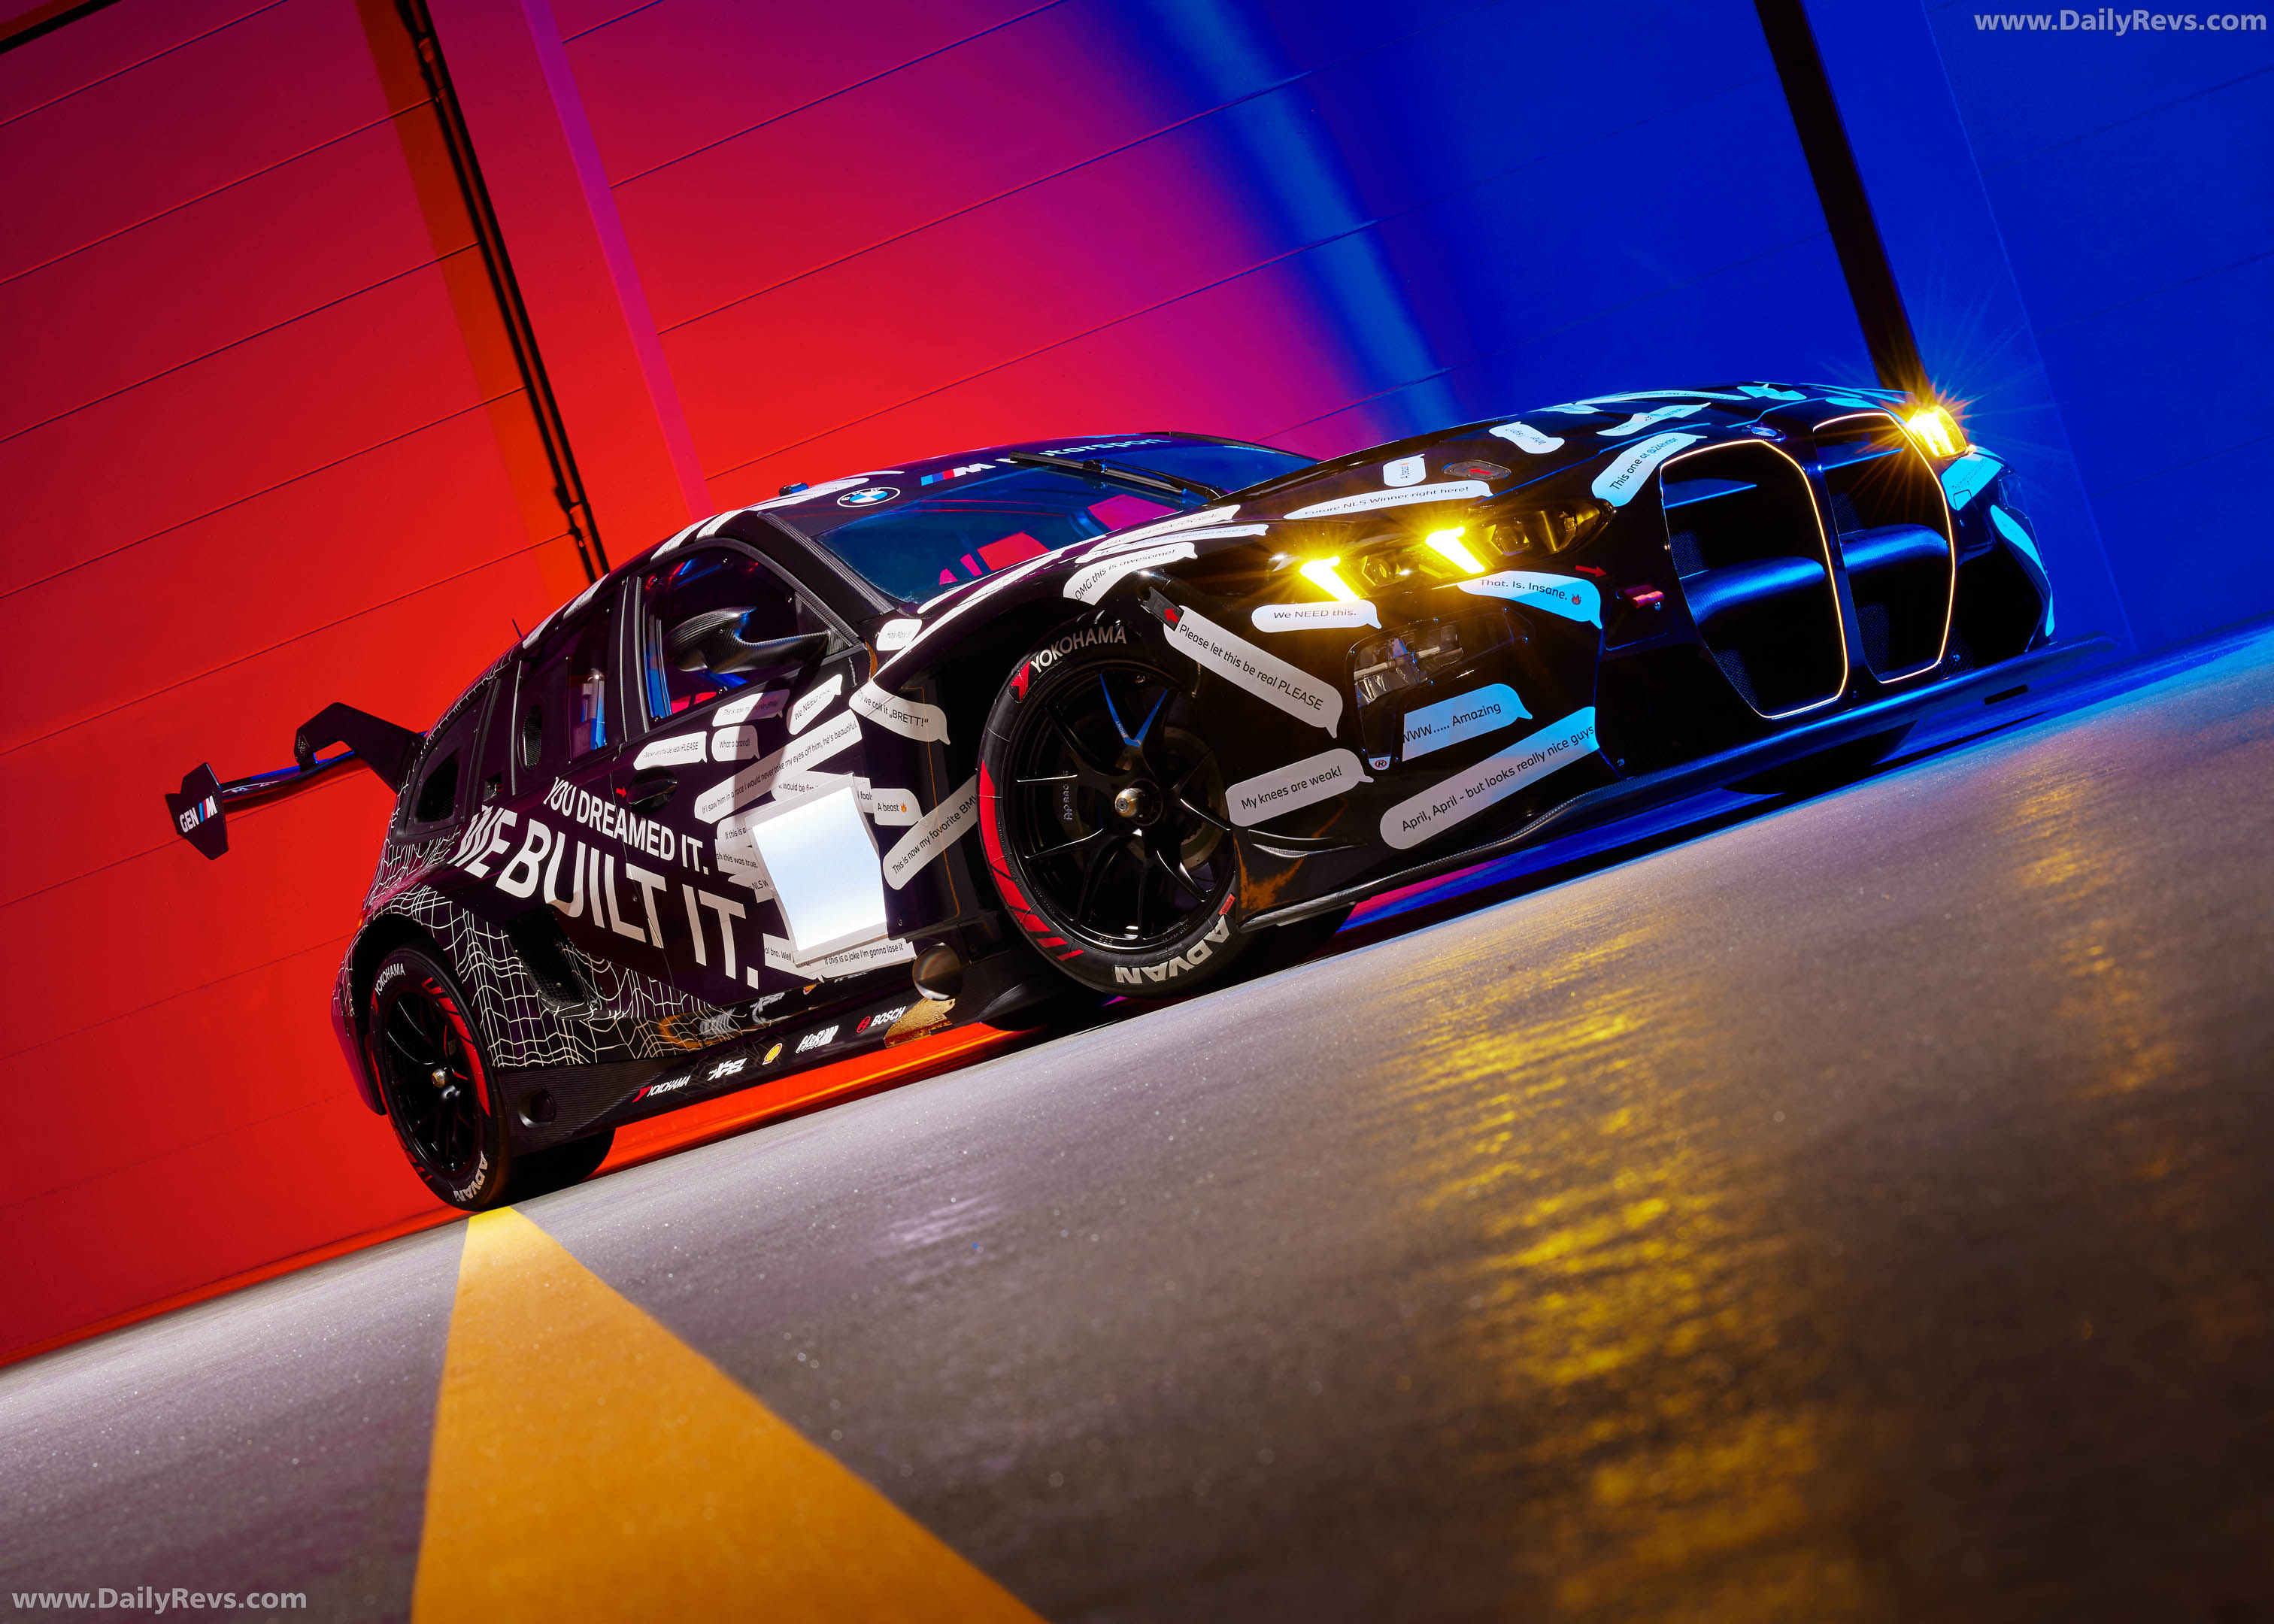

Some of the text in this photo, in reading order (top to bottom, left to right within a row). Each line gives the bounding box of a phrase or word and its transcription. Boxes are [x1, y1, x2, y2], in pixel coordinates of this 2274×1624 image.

[1609, 474, 1630, 490] This
[1627, 459, 1642, 474] one
[1343, 499, 1366, 509] NLS
[1369, 493, 1408, 504] Winner
[1411, 489, 1437, 499] right
[1440, 486, 1469, 495] here!
[1075, 549, 1175, 601] OMG this is awesome!
[1480, 579, 1567, 601] That. Is. Insane.
[1333, 608, 1357, 617] this.
[1031, 626, 1127, 674] YOKOHAMA
[1179, 624, 1324, 710] Please let this be real PLEASE
[794, 710, 802, 720] We
[872, 701, 883, 711] call
[884, 704, 888, 714] it
[1452, 704, 1502, 726] Amazing
[747, 774, 761, 789] would
[761, 768, 774, 781] never
[793, 752, 804, 764] eyes
[1402, 811, 1431, 832] April,
[1432, 795, 1457, 817] April
[1466, 783, 1485, 798] but
[1485, 767, 1515, 787] looks
[1517, 752, 1545, 773] really
[1547, 741, 1569, 756] nice
[1570, 726, 1594, 746] guys
[1241, 765, 1342, 810] My knees are weak!
[179, 807, 199, 833] GEN
[878, 803, 900, 812] A beast
[543, 777, 709, 875] YOU DREAMED IT.
[729, 829, 737, 839] this
[738, 827, 742, 836] is
[892, 860, 904, 874] This
[902, 855, 909, 865] is
[908, 845, 920, 860] now
[919, 835, 932, 849] my
[929, 811, 961, 840] favorite
[723, 853, 732, 862] this
[733, 857, 744, 865] was
[447, 804, 759, 989] WE BUILT IT.
[829, 956, 838, 965] this
[838, 954, 844, 962] is
[848, 952, 860, 963] joke
[869, 947, 887, 959] gonna
[887, 944, 899, 953] lose
[899, 943, 904, 951] it
[1114, 914, 1229, 984] ADVAN
[375, 963, 406, 995] YOKOHAMA
[870, 1005, 907, 1027] BOSCH
[708, 1057, 747, 1081] XPEL
[647, 1075, 691, 1098] YOKOHAMA
[453, 1150, 488, 1201] ADVAN
